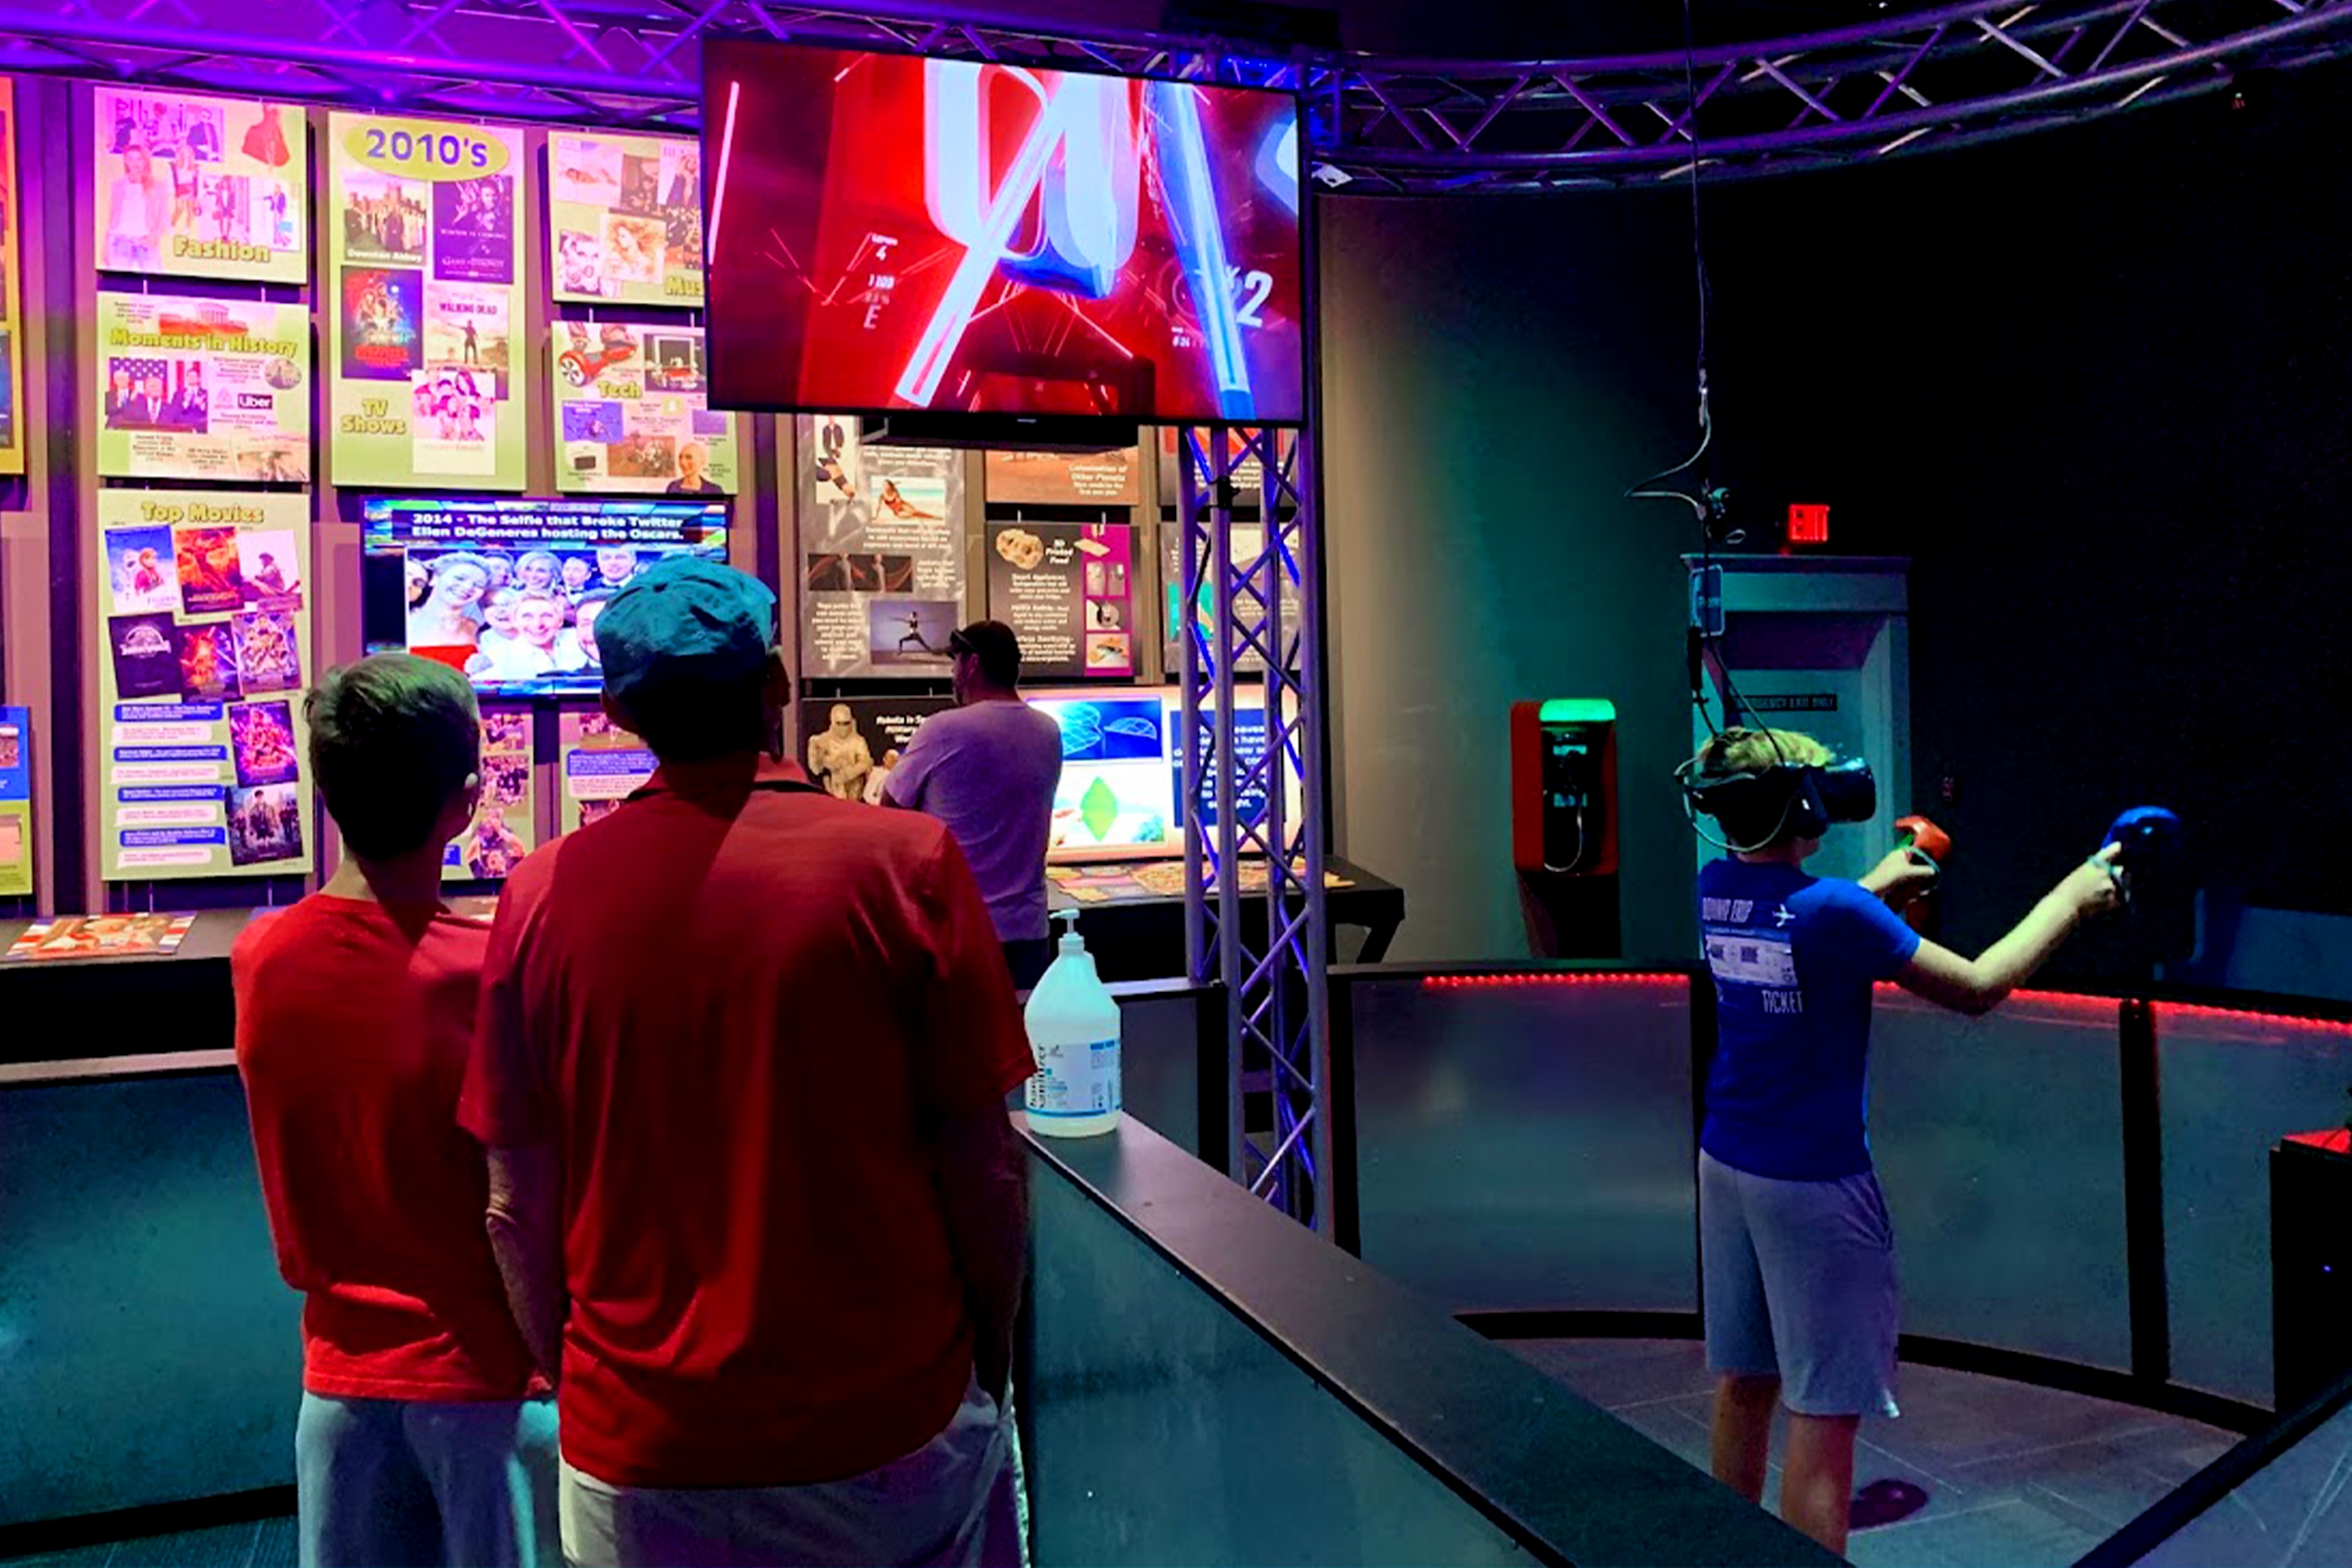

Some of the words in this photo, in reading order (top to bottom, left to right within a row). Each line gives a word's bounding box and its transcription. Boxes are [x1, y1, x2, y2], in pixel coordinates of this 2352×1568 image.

[365, 127, 488, 168] 2010's
[173, 234, 270, 263] Fashion
[664, 274, 704, 297] Mus
[109, 327, 201, 351] Moments
[205, 334, 224, 351] in
[229, 336, 298, 359] History
[238, 394, 270, 408] Uber
[596, 380, 642, 399] Tech
[362, 398, 389, 417] TV
[341, 415, 407, 435] Shows
[140, 501, 184, 524] Top
[188, 503, 265, 523] Movies
[412, 513, 452, 524] 2014
[467, 514, 497, 526] The
[499, 514, 543, 526] Selfie
[546, 515, 579, 527] that
[581, 516, 627, 527] Broke
[629, 517, 684, 528] Twitter
[1789, 504, 1829, 541] EXIT
[412, 526, 451, 538] Ellen
[454, 527, 539, 538] DeGeneres
[541, 528, 599, 540] hosting
[601, 528, 627, 540] the
[629, 529, 685, 541] Oscars.
[1761, 989, 1803, 1014] TICKET
